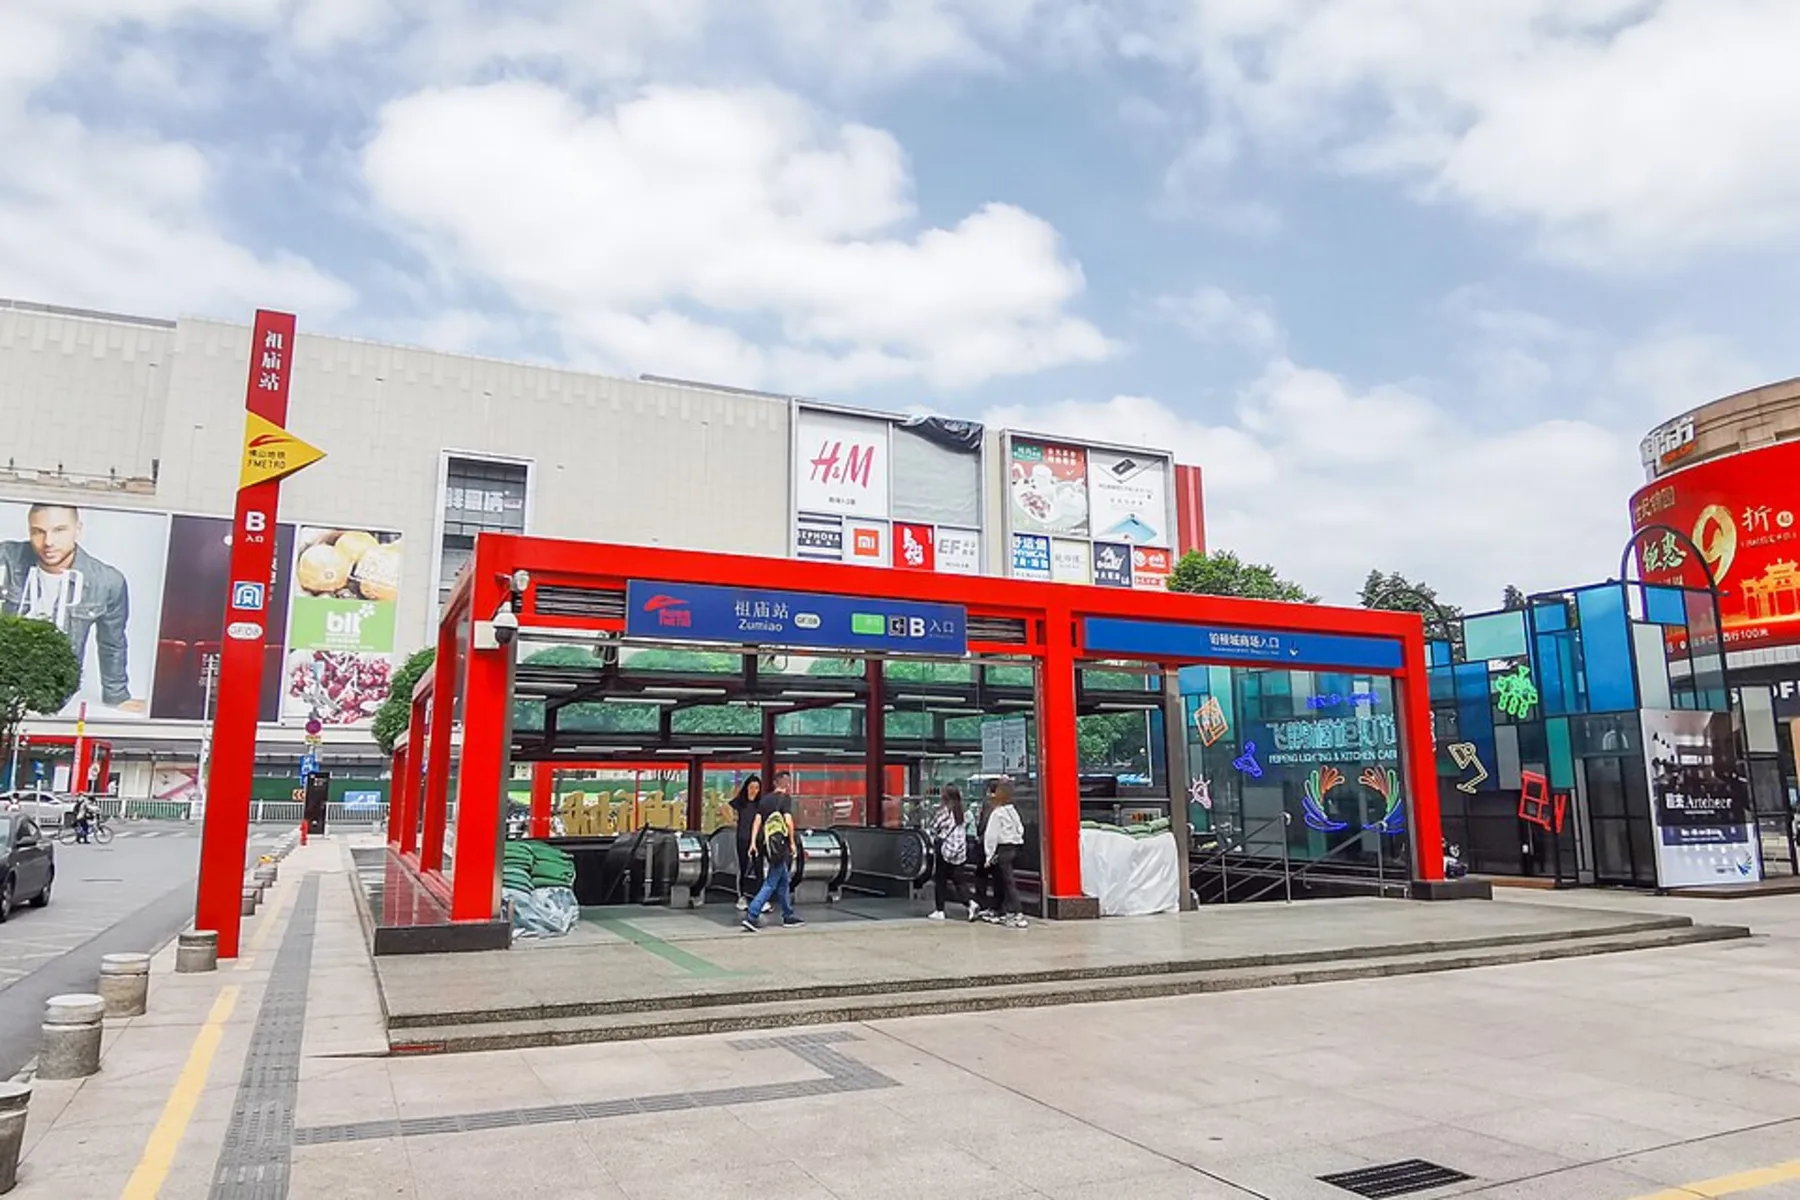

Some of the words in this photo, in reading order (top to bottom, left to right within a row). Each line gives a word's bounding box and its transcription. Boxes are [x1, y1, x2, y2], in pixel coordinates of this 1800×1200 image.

[258, 330, 283, 391] 祖庙站
[810, 440, 875, 488] H&M
[245, 511, 266, 531] B
[1741, 505, 1772, 532] 折
[245, 534, 265, 543] 入口
[938, 538, 961, 555] EF
[735, 600, 788, 619] 祖庙站
[738, 618, 783, 632] Zumiao
[910, 617, 925, 637] B
[929, 619, 954, 633] 入口
